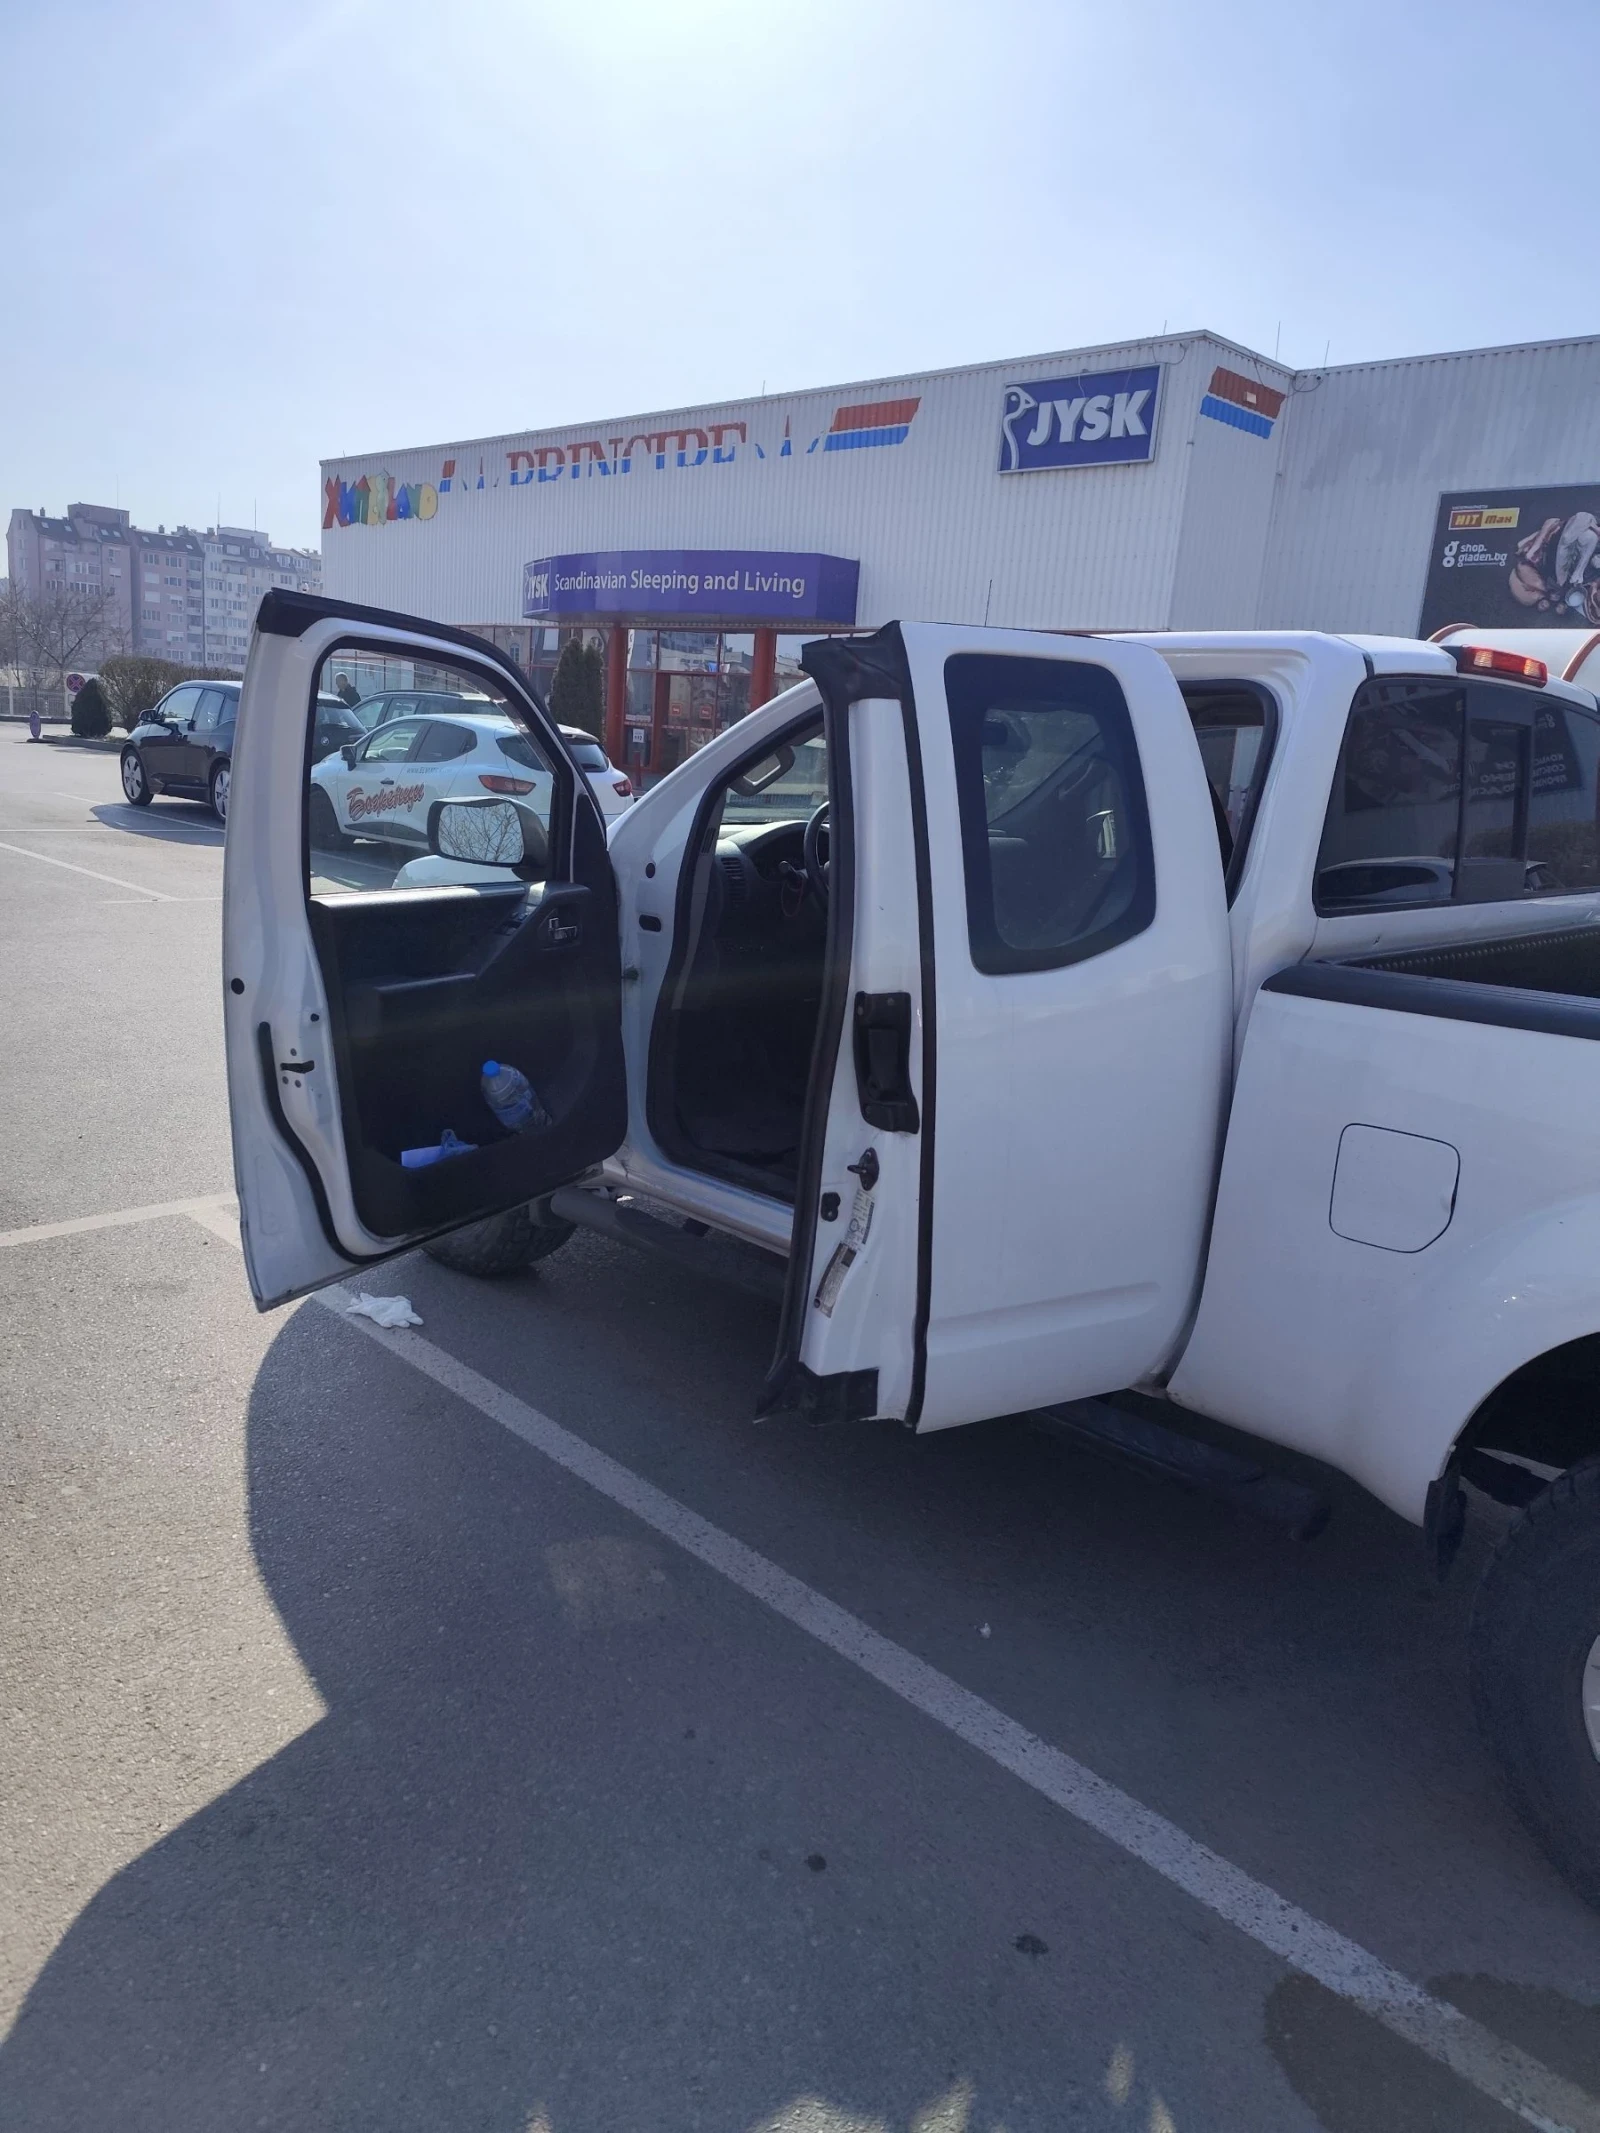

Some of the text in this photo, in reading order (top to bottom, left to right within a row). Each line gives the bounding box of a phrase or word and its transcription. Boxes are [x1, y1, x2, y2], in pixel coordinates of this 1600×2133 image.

[1026, 389, 1152, 446] JYSK
[1455, 514, 1480, 526] HIT
[527, 568, 805, 600] JYSK Scandinavian Sleeping and Living
